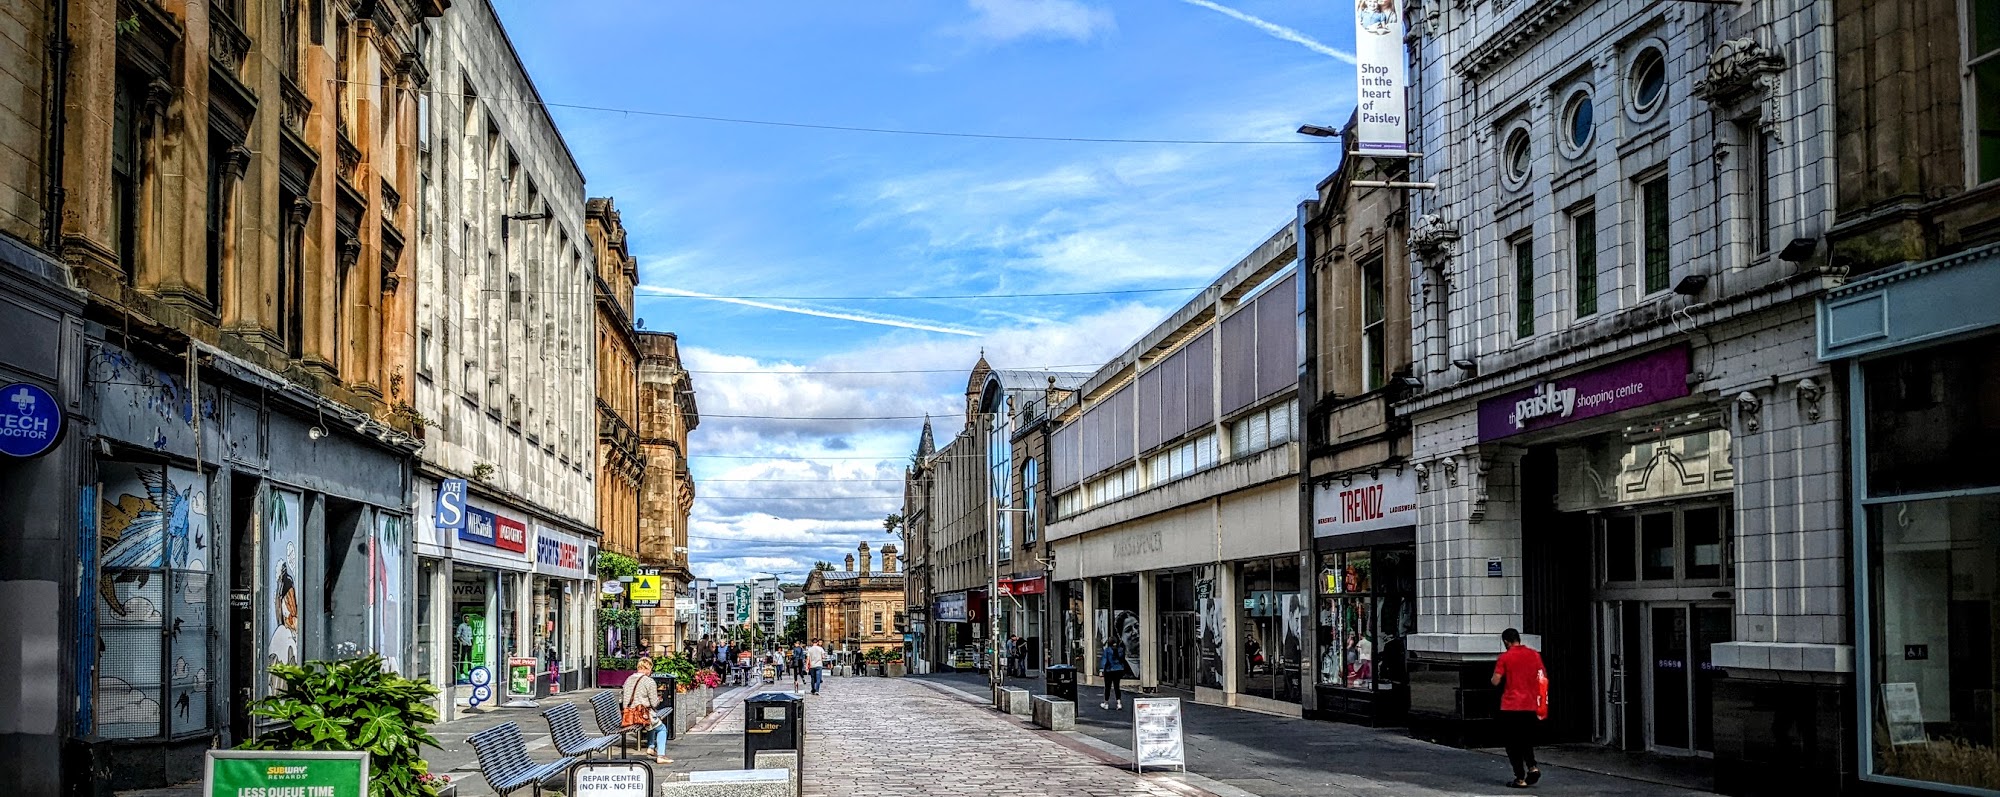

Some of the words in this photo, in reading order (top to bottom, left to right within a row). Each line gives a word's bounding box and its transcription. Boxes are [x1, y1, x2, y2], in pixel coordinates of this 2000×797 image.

[1361, 63, 1389, 76] Shop
[1362, 76, 1372, 86] in
[1374, 76, 1392, 87] the
[1362, 88, 1391, 98] heart
[1362, 100, 1374, 110] of
[1363, 112, 1401, 126] Paisley
[1515, 383, 1576, 430] paisley
[1577, 390, 1614, 408] shopping
[1615, 382, 1643, 398] centre
[443, 482, 461, 492] WH
[440, 491, 461, 526] S
[1340, 484, 1384, 524] TRENDZ
[1390, 503, 1417, 514] LADIESWEAR
[467, 511, 493, 539] WHSmith
[453, 585, 485, 595] WRA
[473, 620, 484, 628] YOU
[473, 628, 484, 636] CAN
[476, 636, 484, 644] DO
[477, 644, 484, 653] IT
[760, 722, 779, 730] Litter
[267, 766, 307, 775] SUBWAY
[238, 787, 266, 797] LESS
[268, 787, 306, 797] QUEUE
[308, 786, 334, 797] TIME
[579, 783, 594, 791] (NO
[627, 783, 644, 791] FEE)
